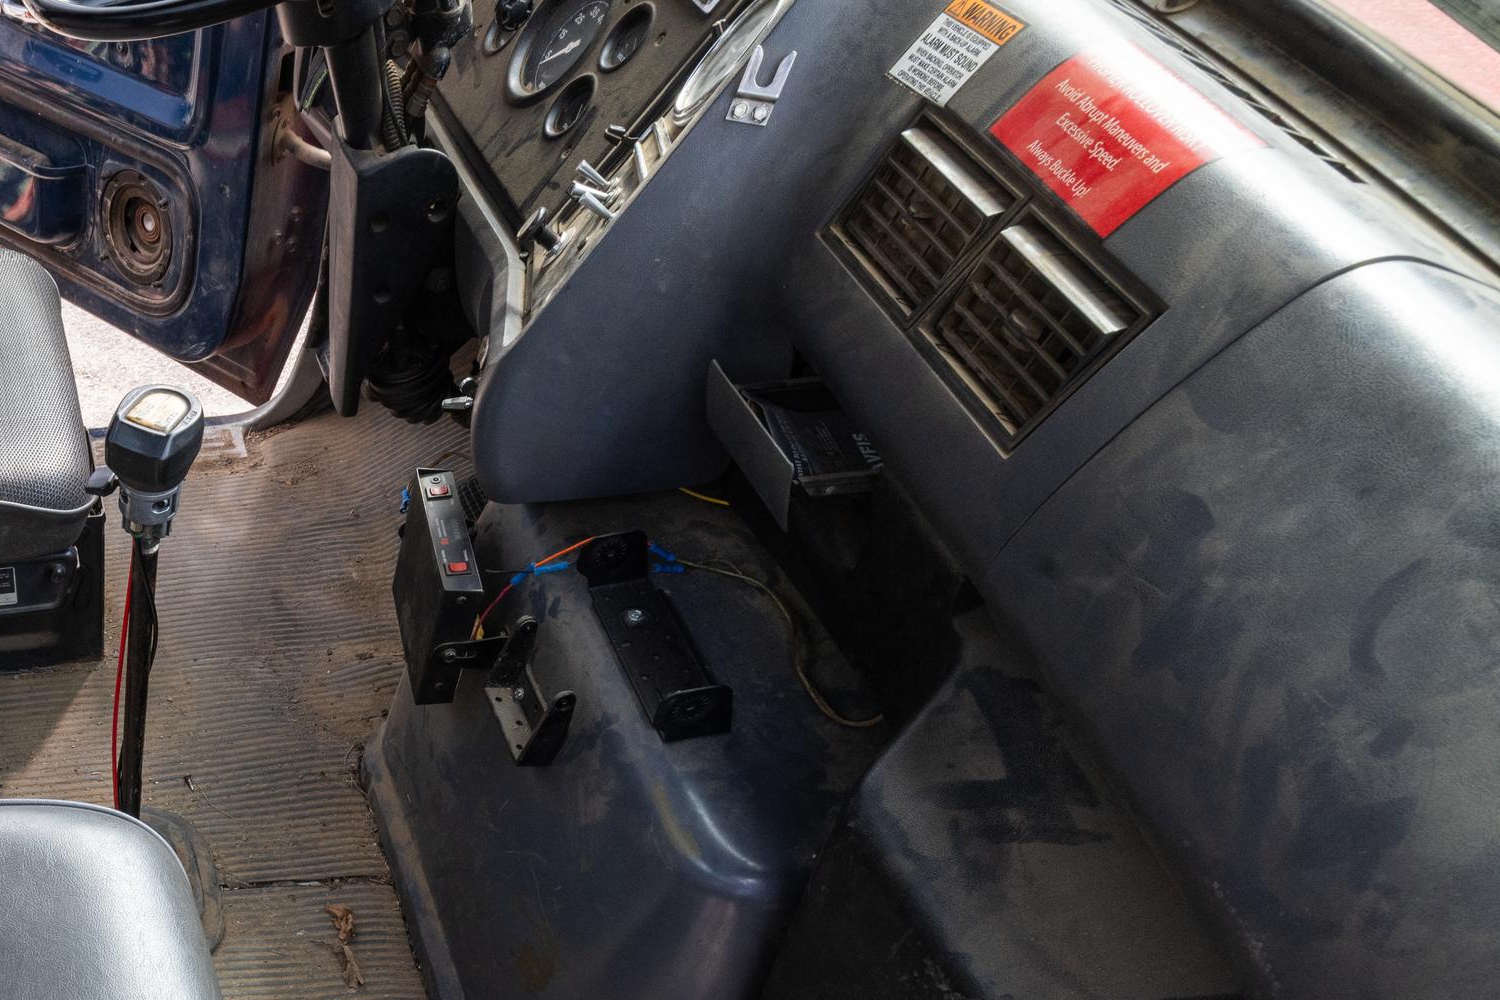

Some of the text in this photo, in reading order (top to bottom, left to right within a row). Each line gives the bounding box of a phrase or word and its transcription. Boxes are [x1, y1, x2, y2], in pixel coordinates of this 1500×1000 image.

[938, 27, 948, 35] WITH
[943, 18, 953, 27] THIS
[951, 24, 968, 36] VEHICLE
[970, 35, 991, 50] EQUIPPED
[962, 2, 1016, 40] WARNING
[916, 47, 928, 57] WHEN
[942, 64, 963, 80] OPERATOR
[921, 33, 977, 72] ALARM MUST SOUND
[897, 70, 918, 86] OPERATING
[916, 82, 926, 91] THIS
[908, 54, 957, 88] MUST MAKE CERTAIN ALARM
[912, 68, 930, 82] WORKING
[927, 78, 944, 91] BEFORE
[1055, 79, 1171, 175] Avoid Abrupt Maneuvers and
[1055, 112, 1122, 173] Excessive Speed.
[1026, 139, 1092, 198] Always Buckle Up!
